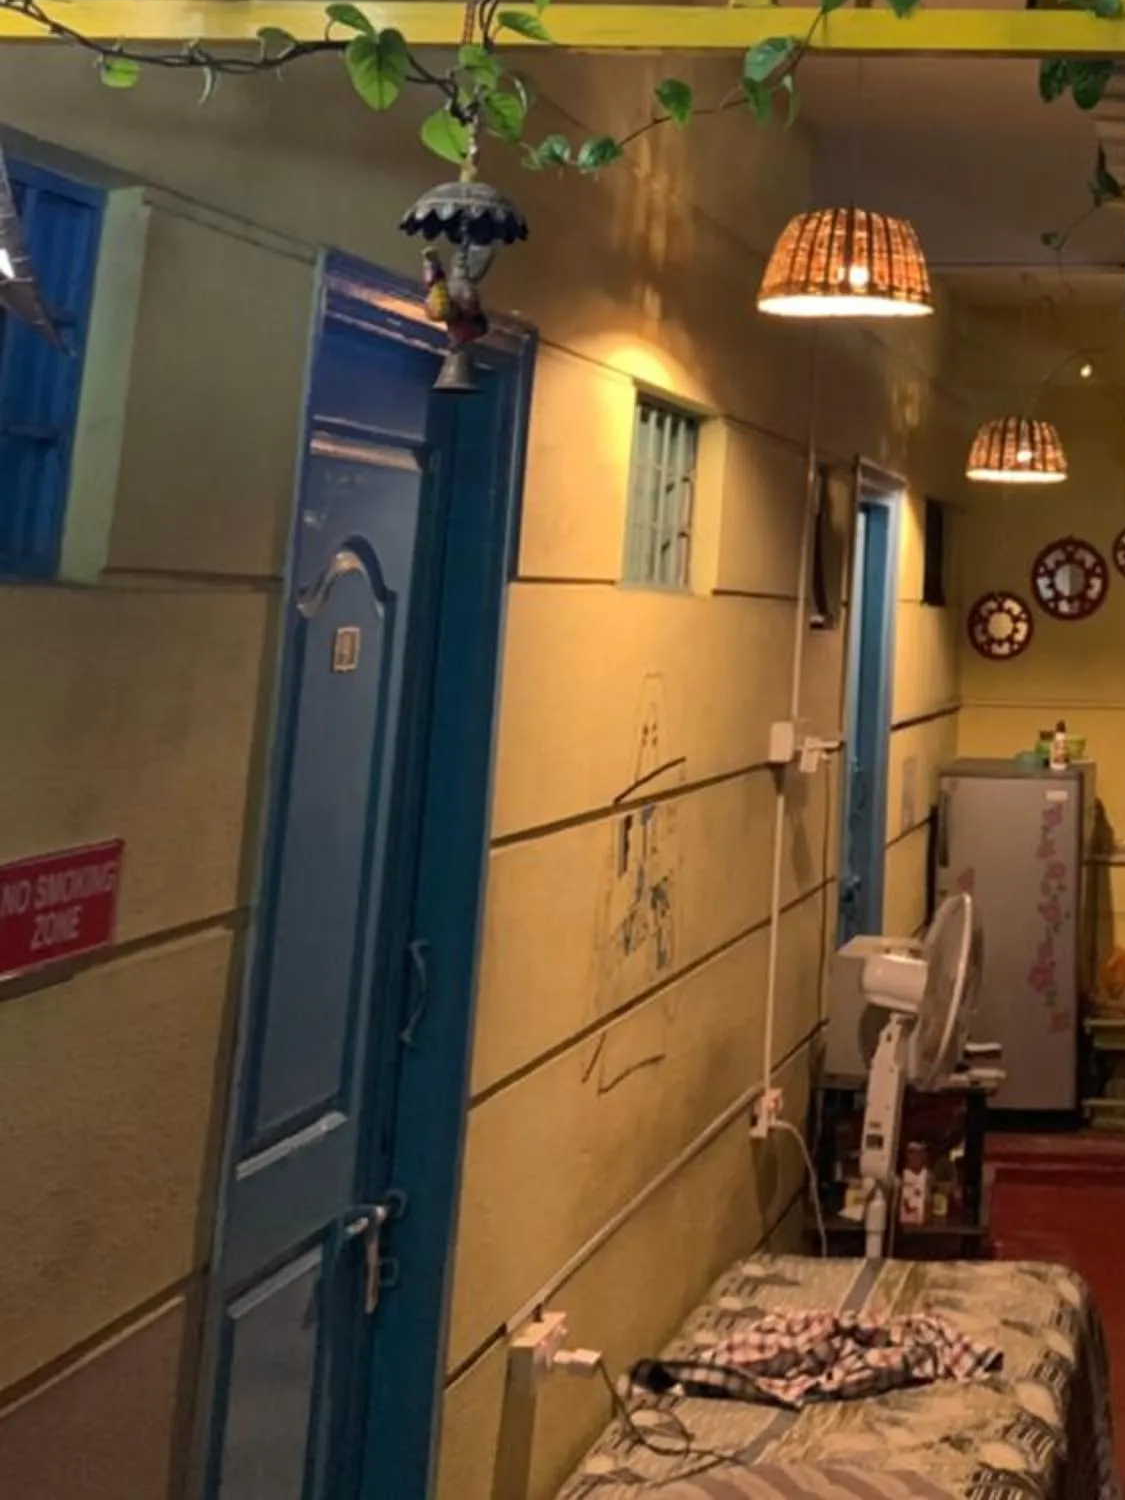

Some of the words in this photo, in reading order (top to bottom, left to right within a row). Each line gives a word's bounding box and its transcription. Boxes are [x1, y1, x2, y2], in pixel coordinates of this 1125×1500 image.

[0, 879, 31, 917] NO
[34, 860, 117, 910] SMOKING
[30, 905, 82, 951] ZONE
